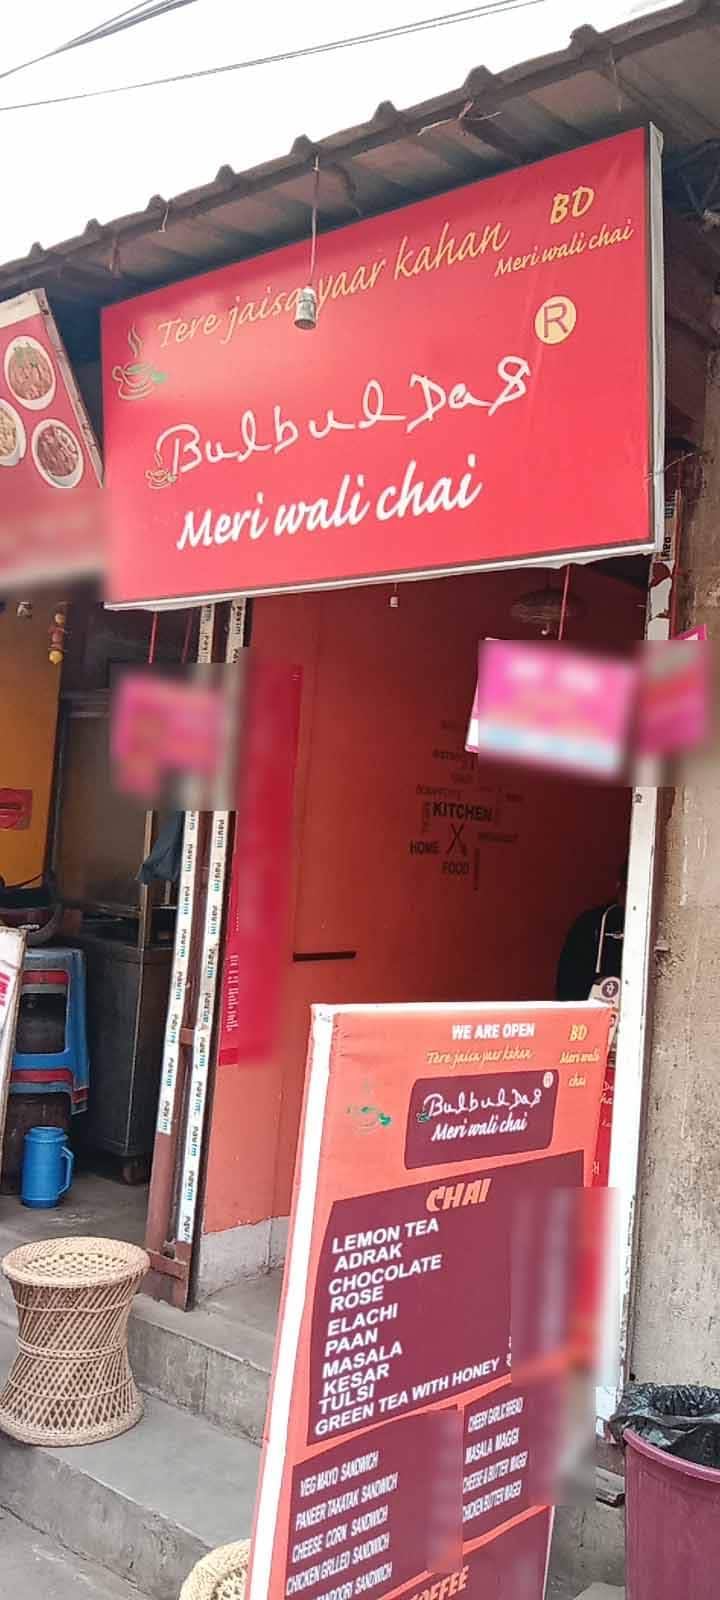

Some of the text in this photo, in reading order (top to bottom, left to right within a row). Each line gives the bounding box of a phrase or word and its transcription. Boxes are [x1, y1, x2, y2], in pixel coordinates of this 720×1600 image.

[550, 186, 595, 224] BD
[494, 218, 633, 277] Meri wali chai
[158, 221, 511, 348] Tere jaisa yaar kahan
[155, 378, 406, 475] Bulbul
[176, 453, 484, 551] Meri wali chai
[432, 801, 493, 822] KITCHEN
[409, 840, 441, 856] HOME
[442, 861, 470, 876] FOOD
[452, 1023, 535, 1040] WE ARE OPEN
[569, 1024, 588, 1041] BD
[424, 1088, 509, 1117] Bulbul
[431, 1112, 528, 1142] Meri wali chai
[426, 1178, 492, 1212] CHAI
[332, 1217, 440, 1254] LEMON TEA
[334, 1243, 403, 1273] ADRAK
[328, 1254, 442, 1296] CHOCOLATE
[330, 1285, 384, 1312] ROSE
[327, 1304, 398, 1337] ELACHI
[324, 1328, 378, 1357] PAAN
[322, 1341, 403, 1379] MASALA
[315, 1357, 500, 1436] GREEN TEA WITH HONEY
[323, 1364, 390, 1397] KESAR
[318, 1385, 374, 1415] TULSI
[465, 1438, 493, 1464] MASALA
[300, 1450, 379, 1497] VEG MAYO SANDWICH
[295, 1503, 327, 1531] PANEER
[361, 1472, 399, 1504] SANDWICH
[292, 1504, 388, 1563] CHEESE CORN SANDWICH
[286, 1563, 320, 1596] CHICKEN
[351, 1532, 390, 1565] SANDWICH
[355, 1562, 392, 1594] SANDWICH
